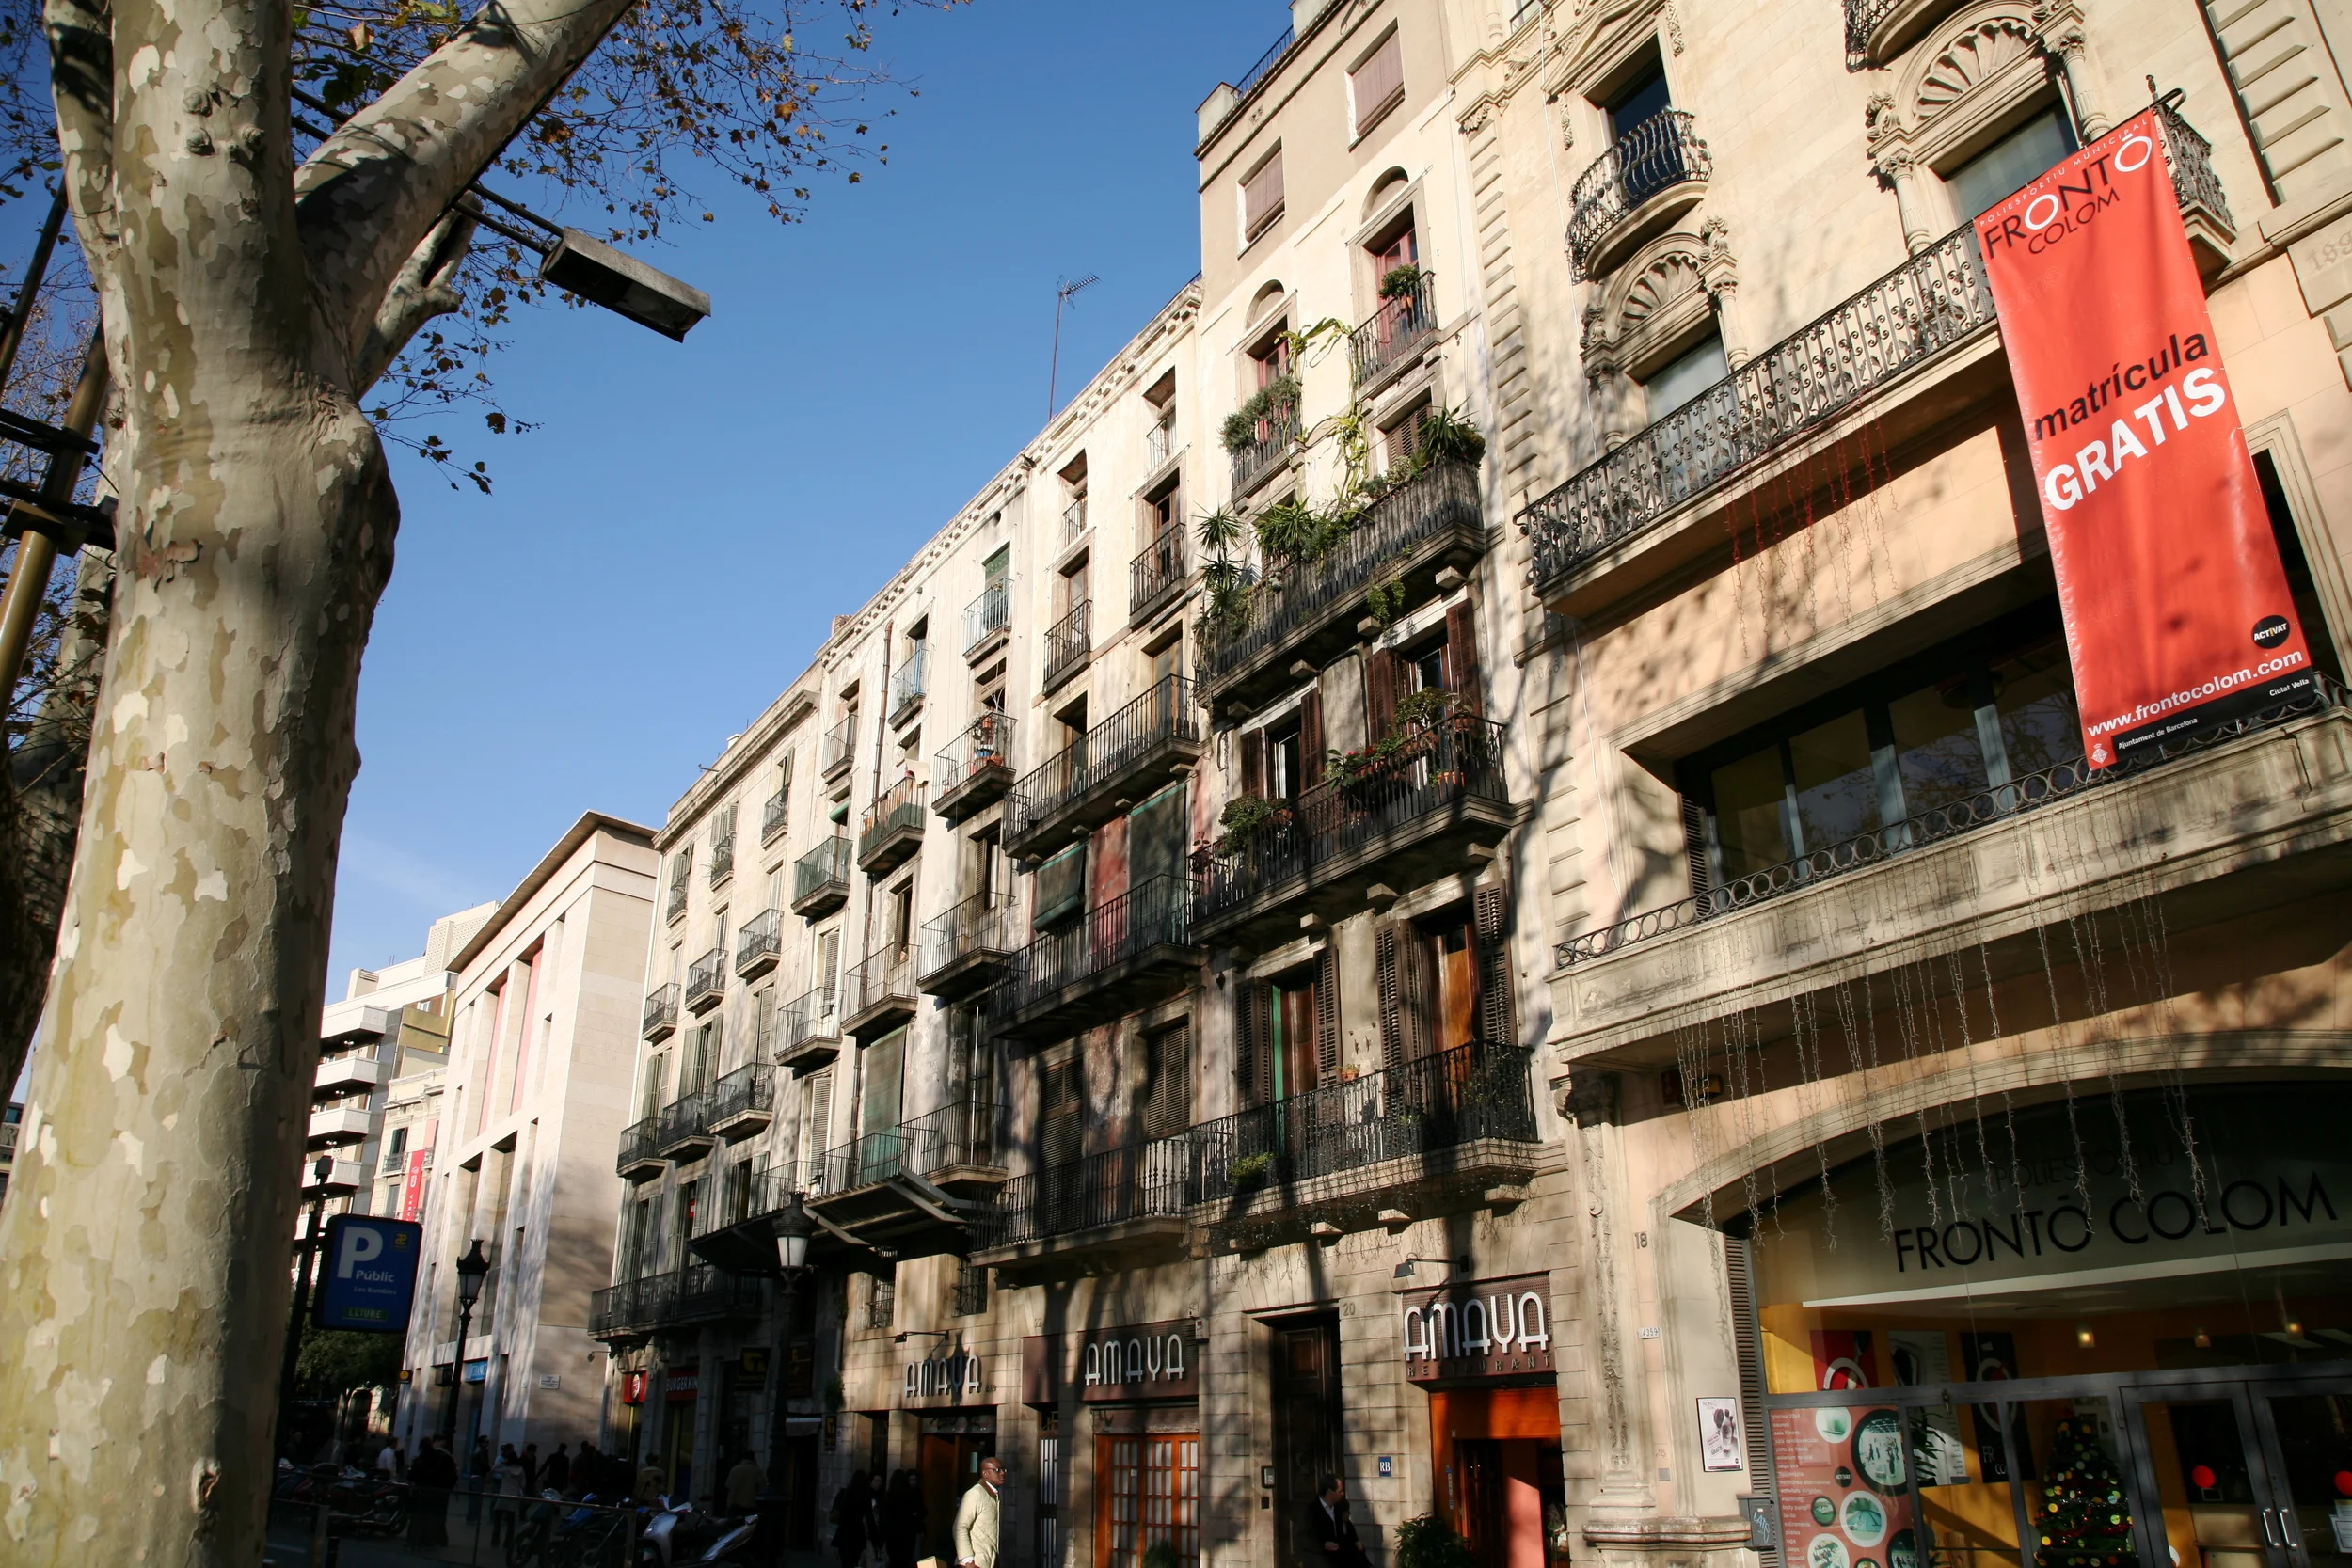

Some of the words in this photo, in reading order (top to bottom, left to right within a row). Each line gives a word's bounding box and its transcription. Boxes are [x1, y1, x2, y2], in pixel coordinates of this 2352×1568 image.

[1979, 167, 2066, 227] POLIESPORTIU
[2073, 119, 2148, 166] MUNICIPAL
[2028, 187, 2120, 255] COLOM
[2034, 333, 2209, 441] matrícula
[2044, 367, 2226, 511] GRATIS
[2087, 649, 2303, 736] www.frontocolom.com
[2269, 685, 2291, 697] Ciutat
[2291, 678, 2310, 689] Vella
[2118, 732, 2156, 750] Ajuntament
[2156, 728, 2165, 736] de
[2166, 718, 2198, 734] Barcelona
[2110, 1172, 2336, 1245] COLOM
[337, 1226, 383, 1278] P
[1634, 1231, 1647, 1249] 18
[356, 1270, 395, 1282] Públic
[348, 1309, 382, 1319] LLIURE
[1343, 1302, 1356, 1316] 20
[1404, 1291, 1549, 1362] AMAYA
[905, 1355, 982, 1398] AMAYA
[1085, 1333, 1184, 1386] AMAYA
[666, 1377, 687, 1392] BURGER
[688, 1375, 698, 1390] KIN
[1379, 1462, 1391, 1472] RB
